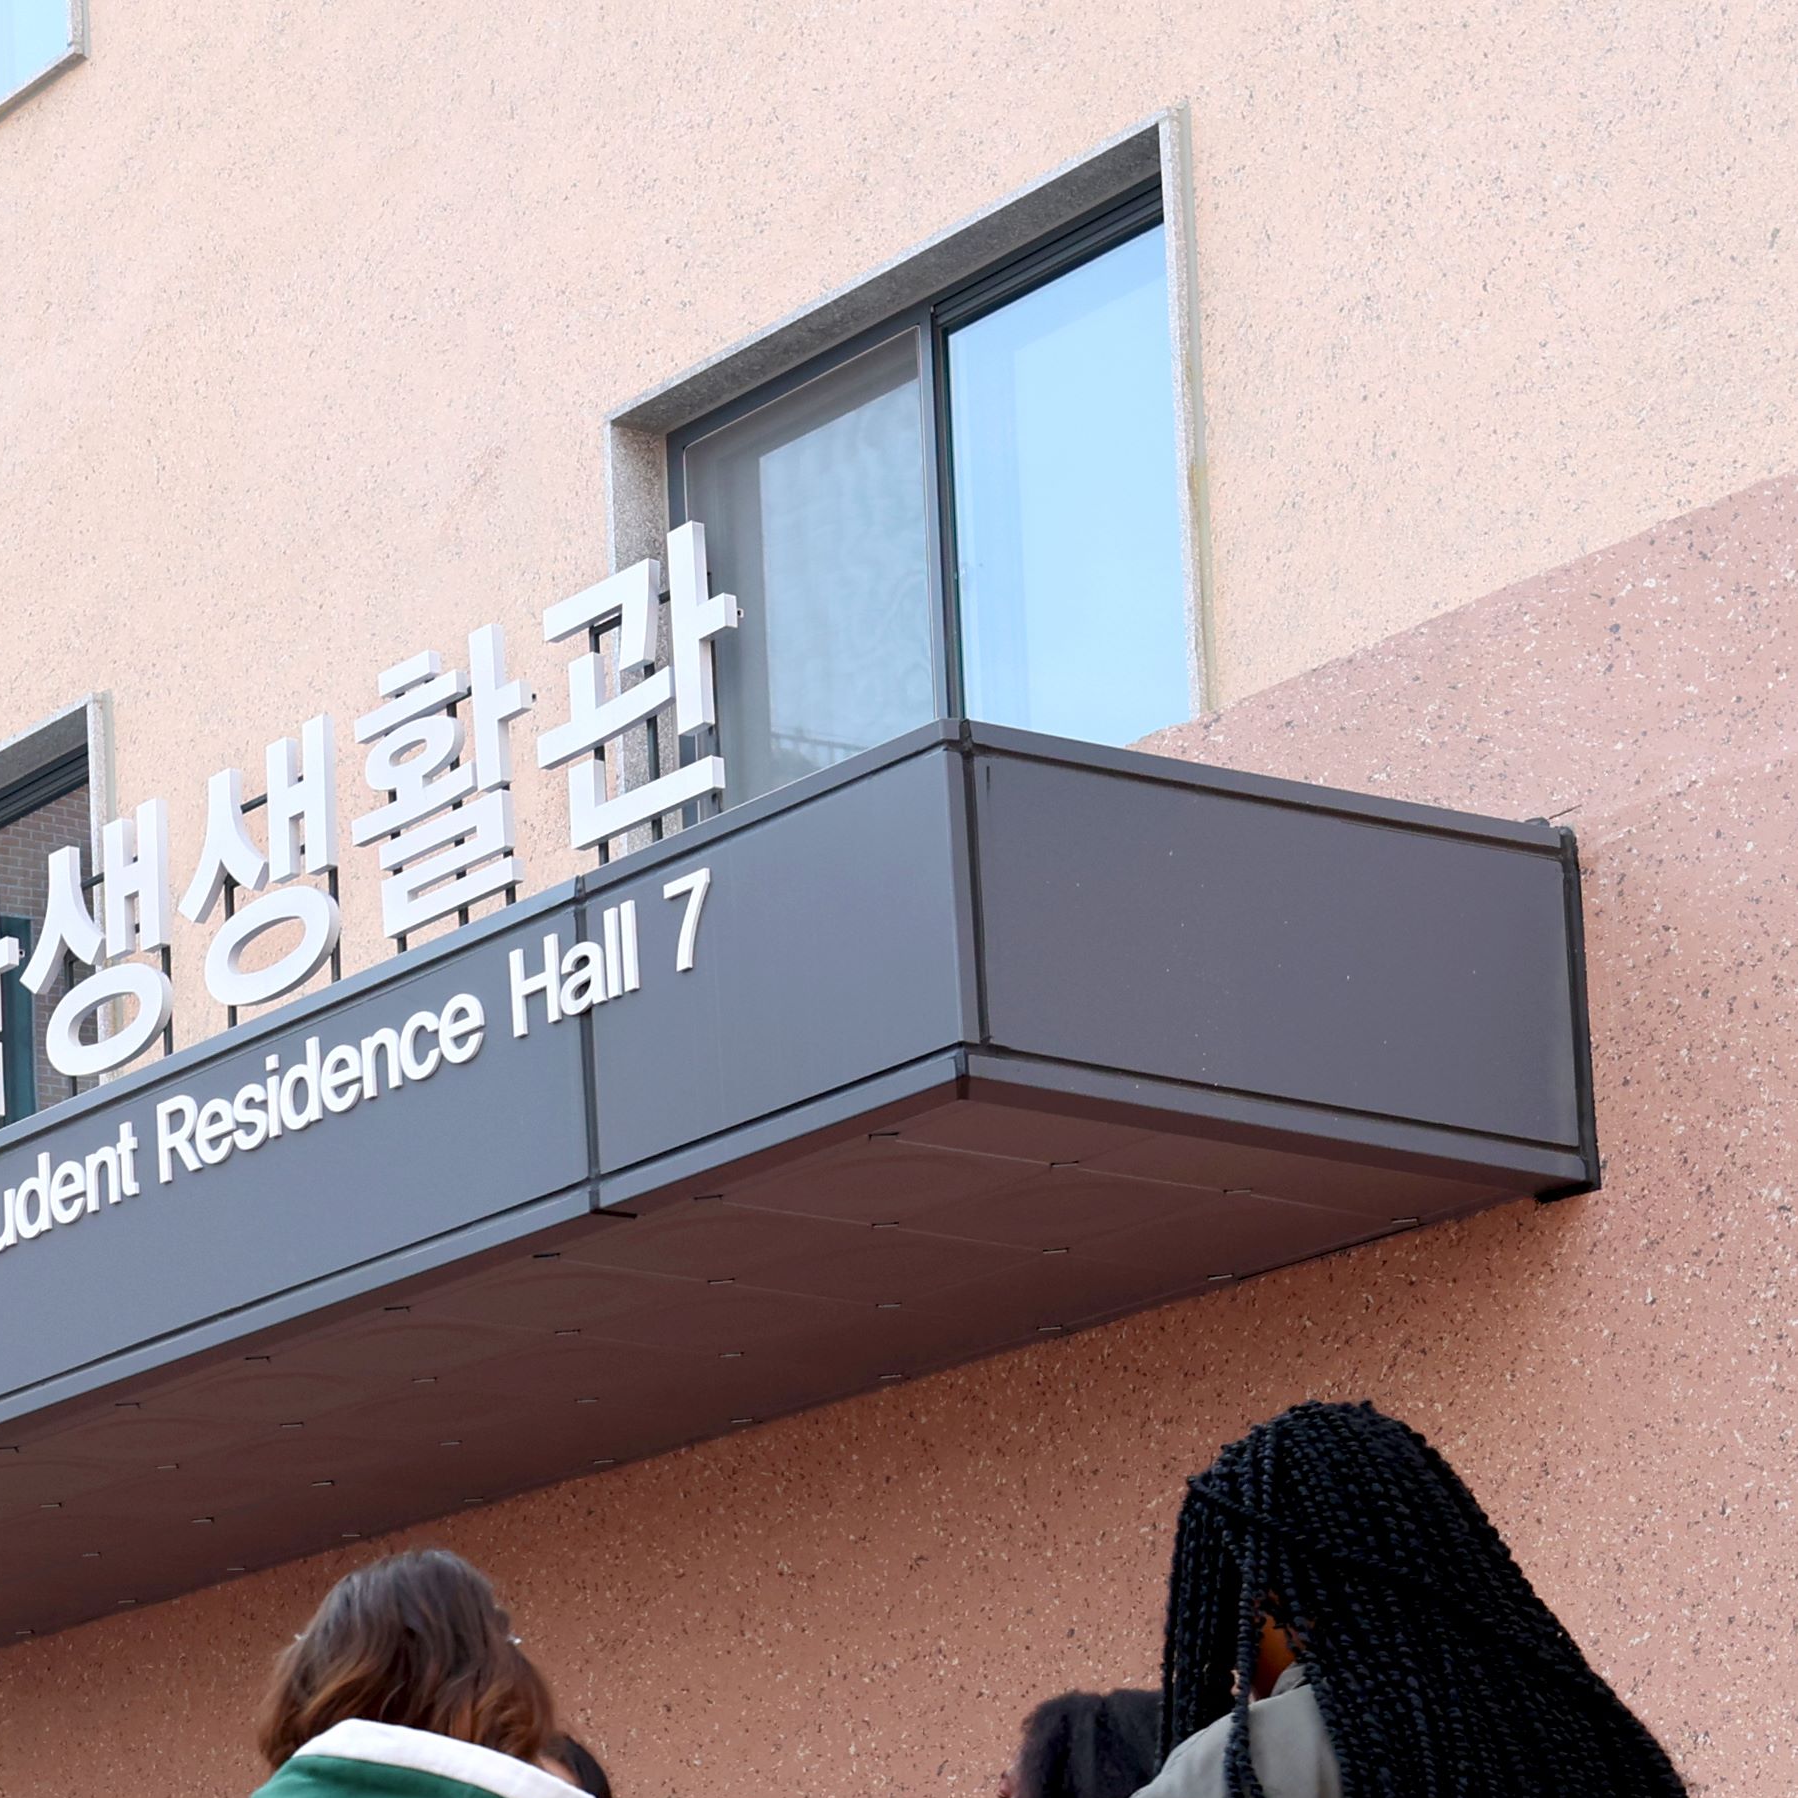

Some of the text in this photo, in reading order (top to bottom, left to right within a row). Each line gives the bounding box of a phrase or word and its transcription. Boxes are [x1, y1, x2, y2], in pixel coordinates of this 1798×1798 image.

[158, 992, 486, 1184] Residence
[509, 898, 641, 1038] Hall
[663, 867, 711, 973] 7
